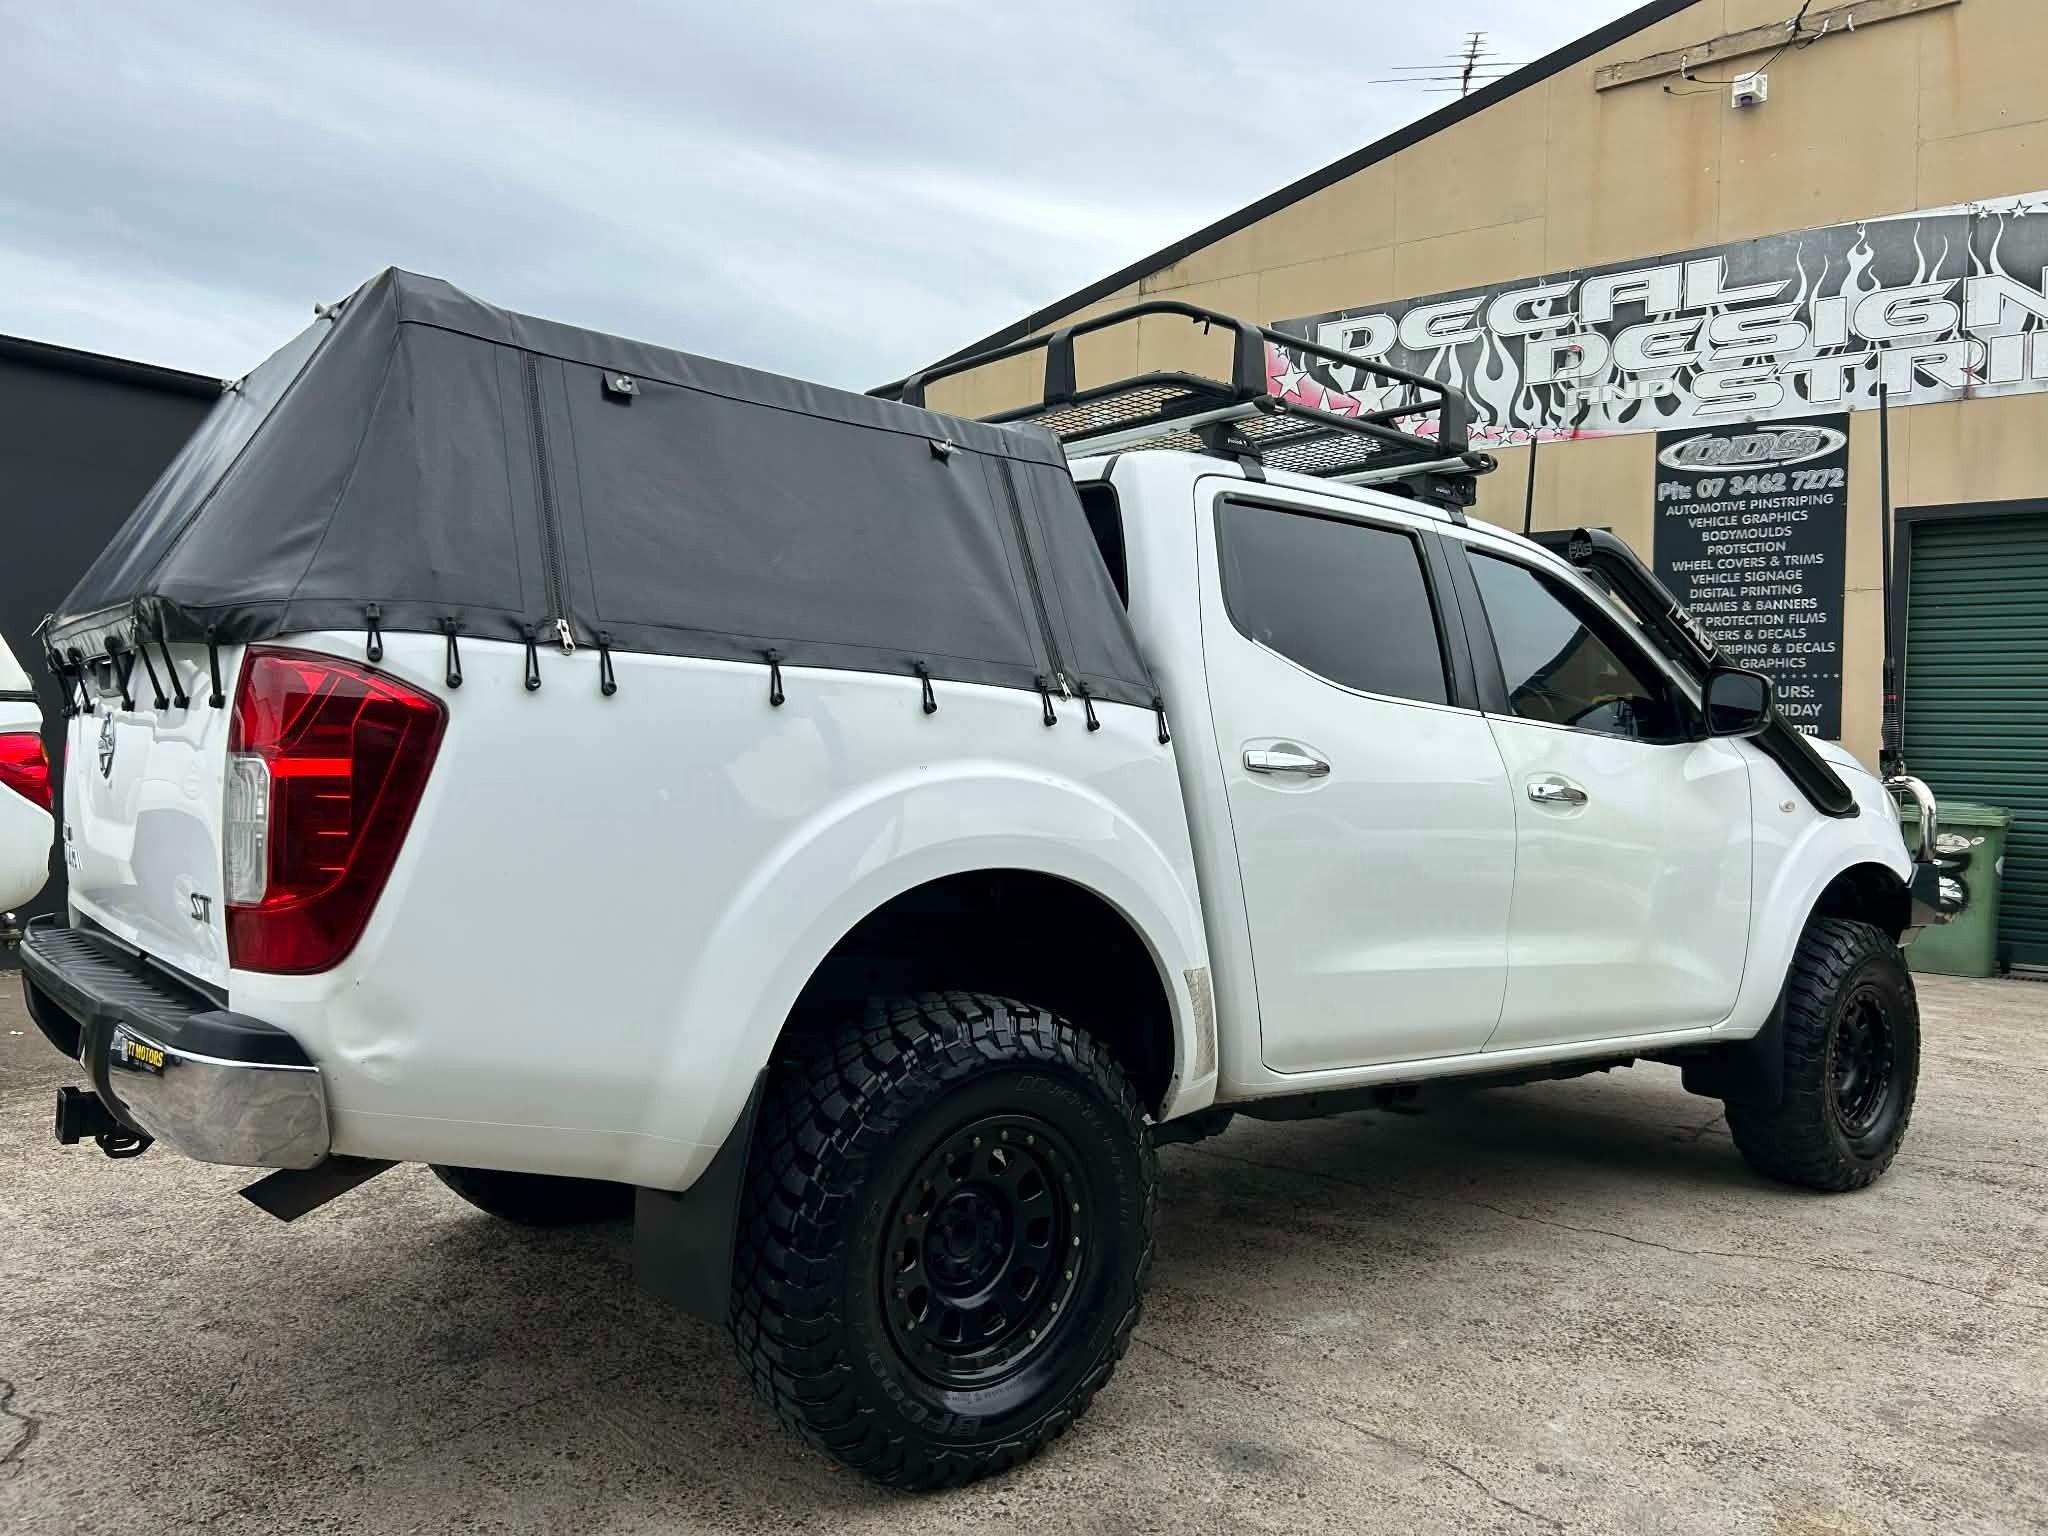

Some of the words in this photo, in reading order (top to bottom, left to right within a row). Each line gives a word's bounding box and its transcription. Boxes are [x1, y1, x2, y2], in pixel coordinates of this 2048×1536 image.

[1316, 255, 1792, 367] DECAL
[1565, 377, 1675, 407] AND
[1689, 329, 2048, 417] STRI
[1696, 477, 1726, 499] 07
[1729, 472, 1787, 496] 3462
[1791, 468, 1845, 491] 7272
[1666, 500, 1746, 517] AUTOMOTIVE
[1750, 493, 1834, 510] PINSTRIPING
[1688, 515, 1738, 529] VEHICLE
[1742, 510, 1809, 526] GRAPHICS
[1702, 526, 1793, 542] BODYMOULDS
[1707, 541, 1787, 556] PROTECTION
[1672, 560, 1714, 572] WHEEL
[1717, 557, 1766, 570] COVERS
[1770, 555, 1780, 567] &
[1784, 553, 1825, 566] TRIMS
[1690, 573, 1741, 585] VEHICLE
[1744, 569, 1803, 583] SIGNAGE
[1690, 587, 1737, 599] DIGITAL
[1740, 584, 1803, 597] PRINTING
[1684, 601, 1738, 613] -FRAMES
[1742, 600, 1752, 611] &
[1756, 598, 1818, 611] BANNERS
[1705, 614, 1784, 626] PROTECTION
[1789, 612, 1827, 624] FILMS
[1707, 630, 1740, 641] KERS
[1743, 629, 1754, 640] &
[1758, 627, 1807, 640] DECALS
[1771, 643, 1782, 653] &
[1786, 641, 1836, 653] DECALS
[1740, 657, 1807, 669] GRAPHICS
[1777, 685, 1815, 698] URS:
[1775, 703, 1823, 717] RIDAY
[190, 892, 212, 924] ST
[135, 1044, 164, 1067] MOTORS
